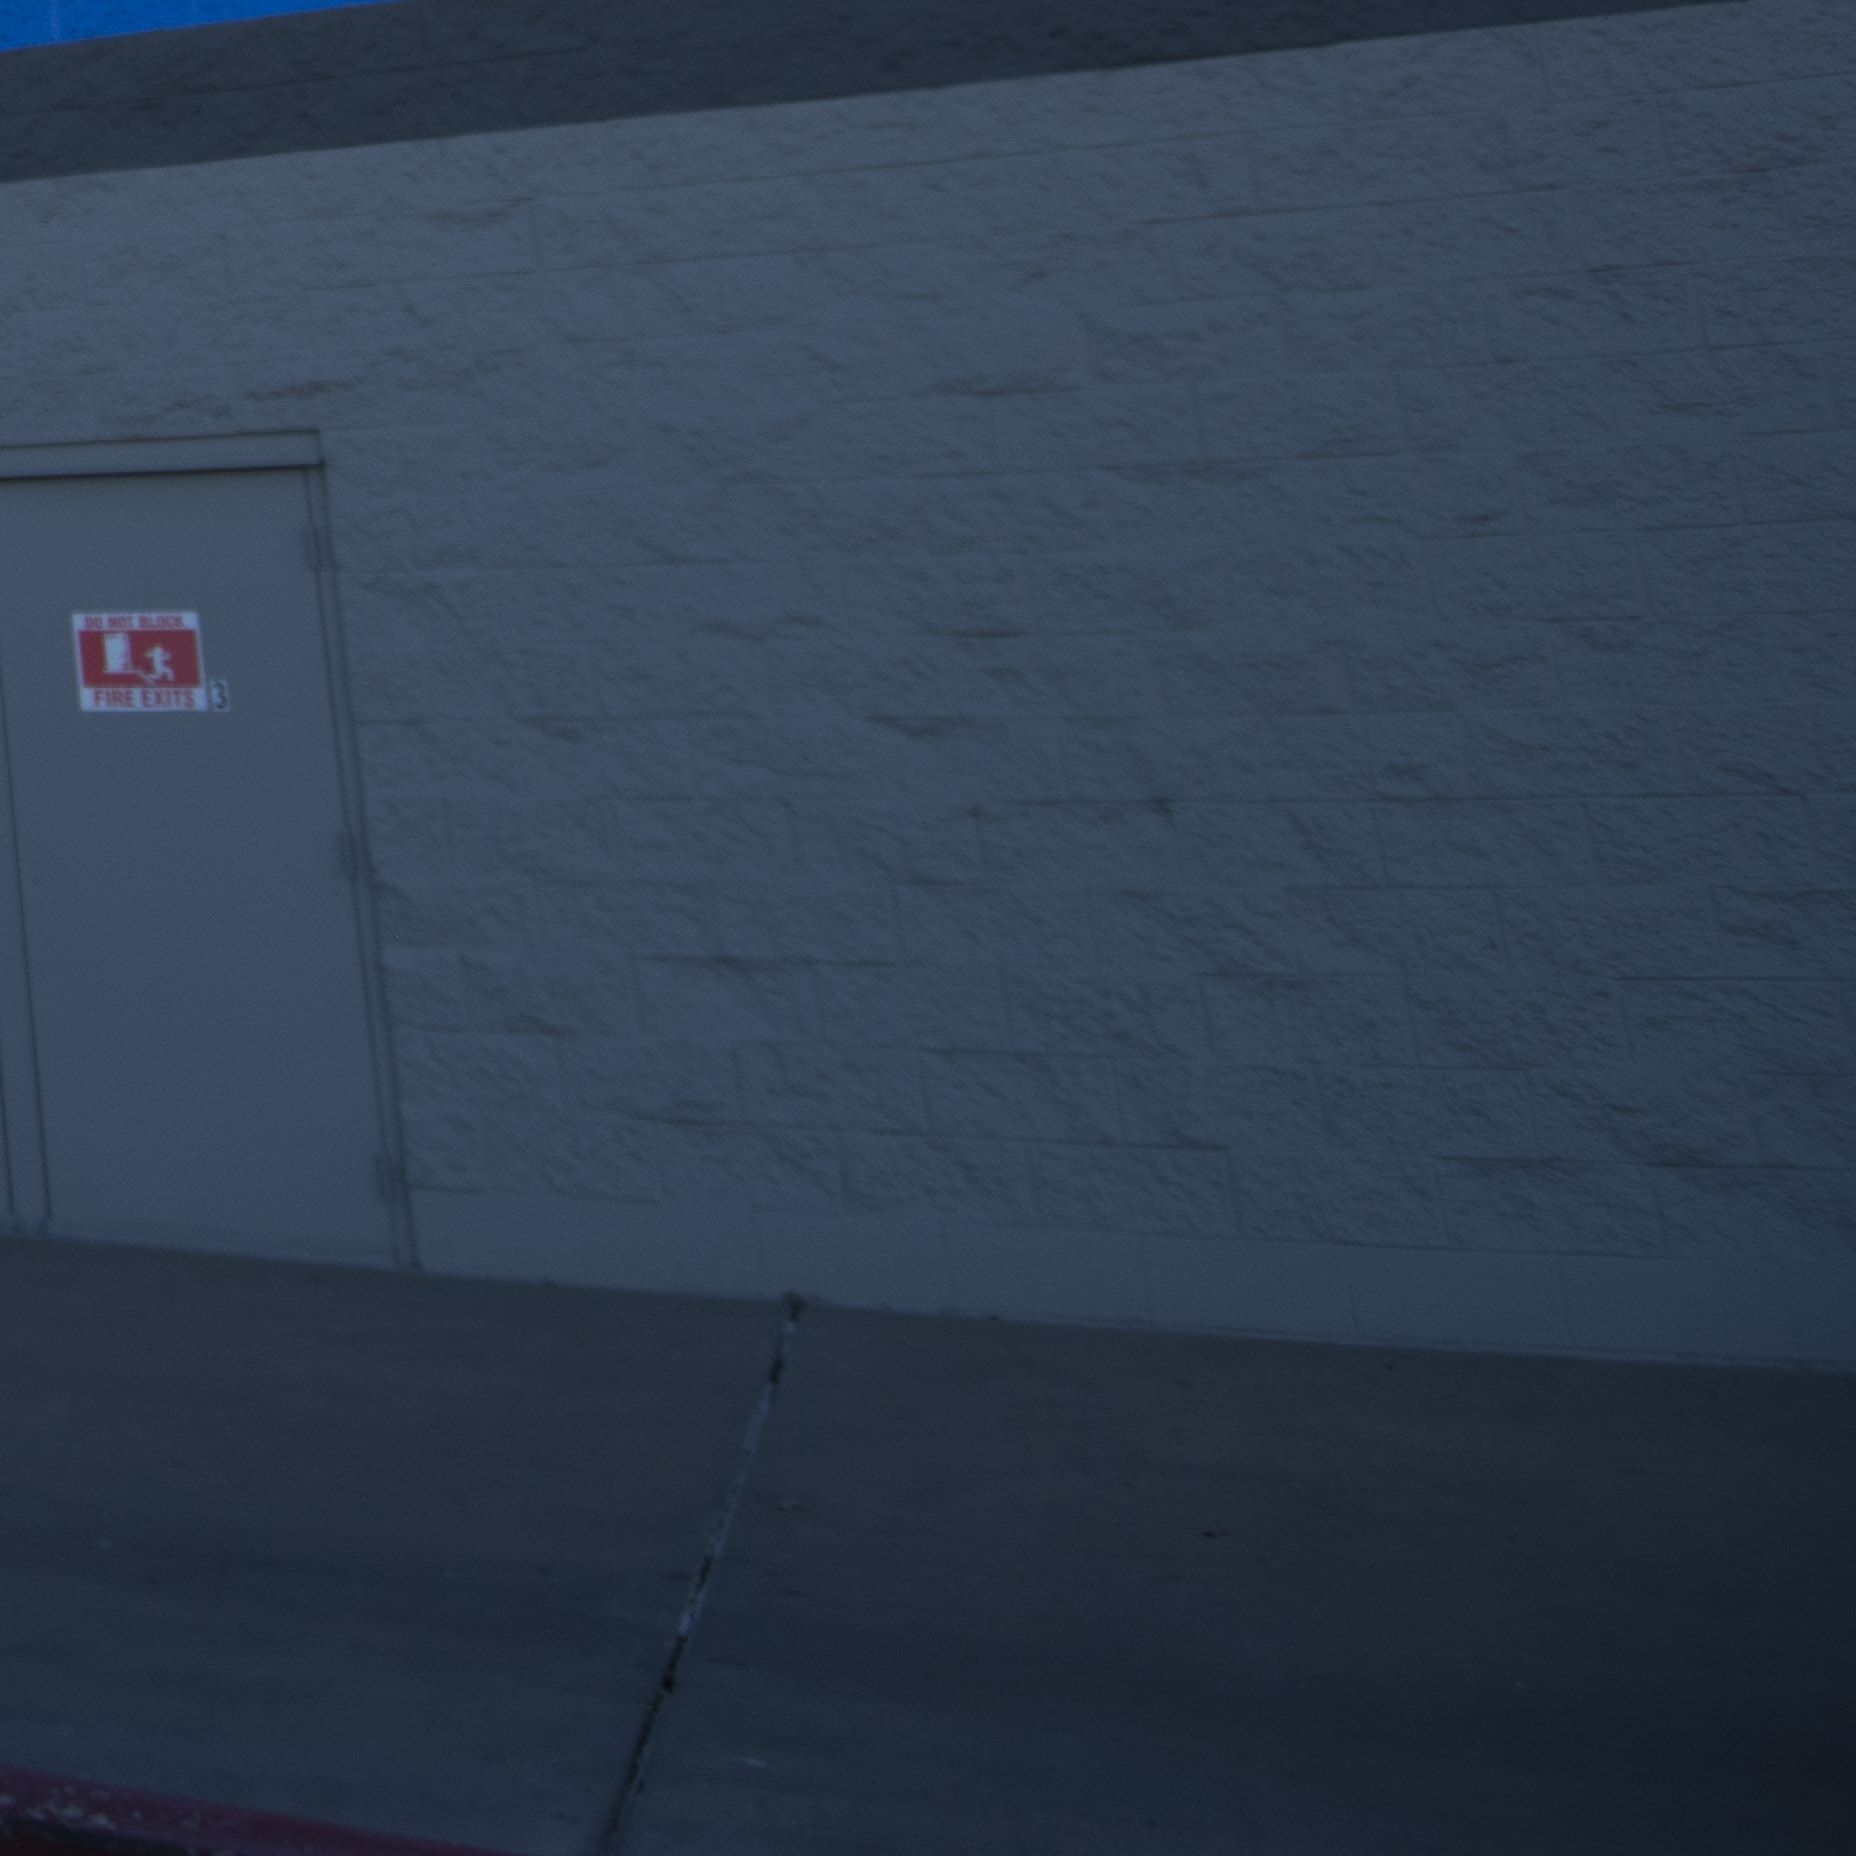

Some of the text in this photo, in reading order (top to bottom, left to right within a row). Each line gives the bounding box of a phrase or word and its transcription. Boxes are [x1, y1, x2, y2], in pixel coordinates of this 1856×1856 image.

[85, 614, 183, 629] DO NOT BLOCK
[94, 689, 195, 708] FIRE EXITS
[213, 682, 228, 710] 3
